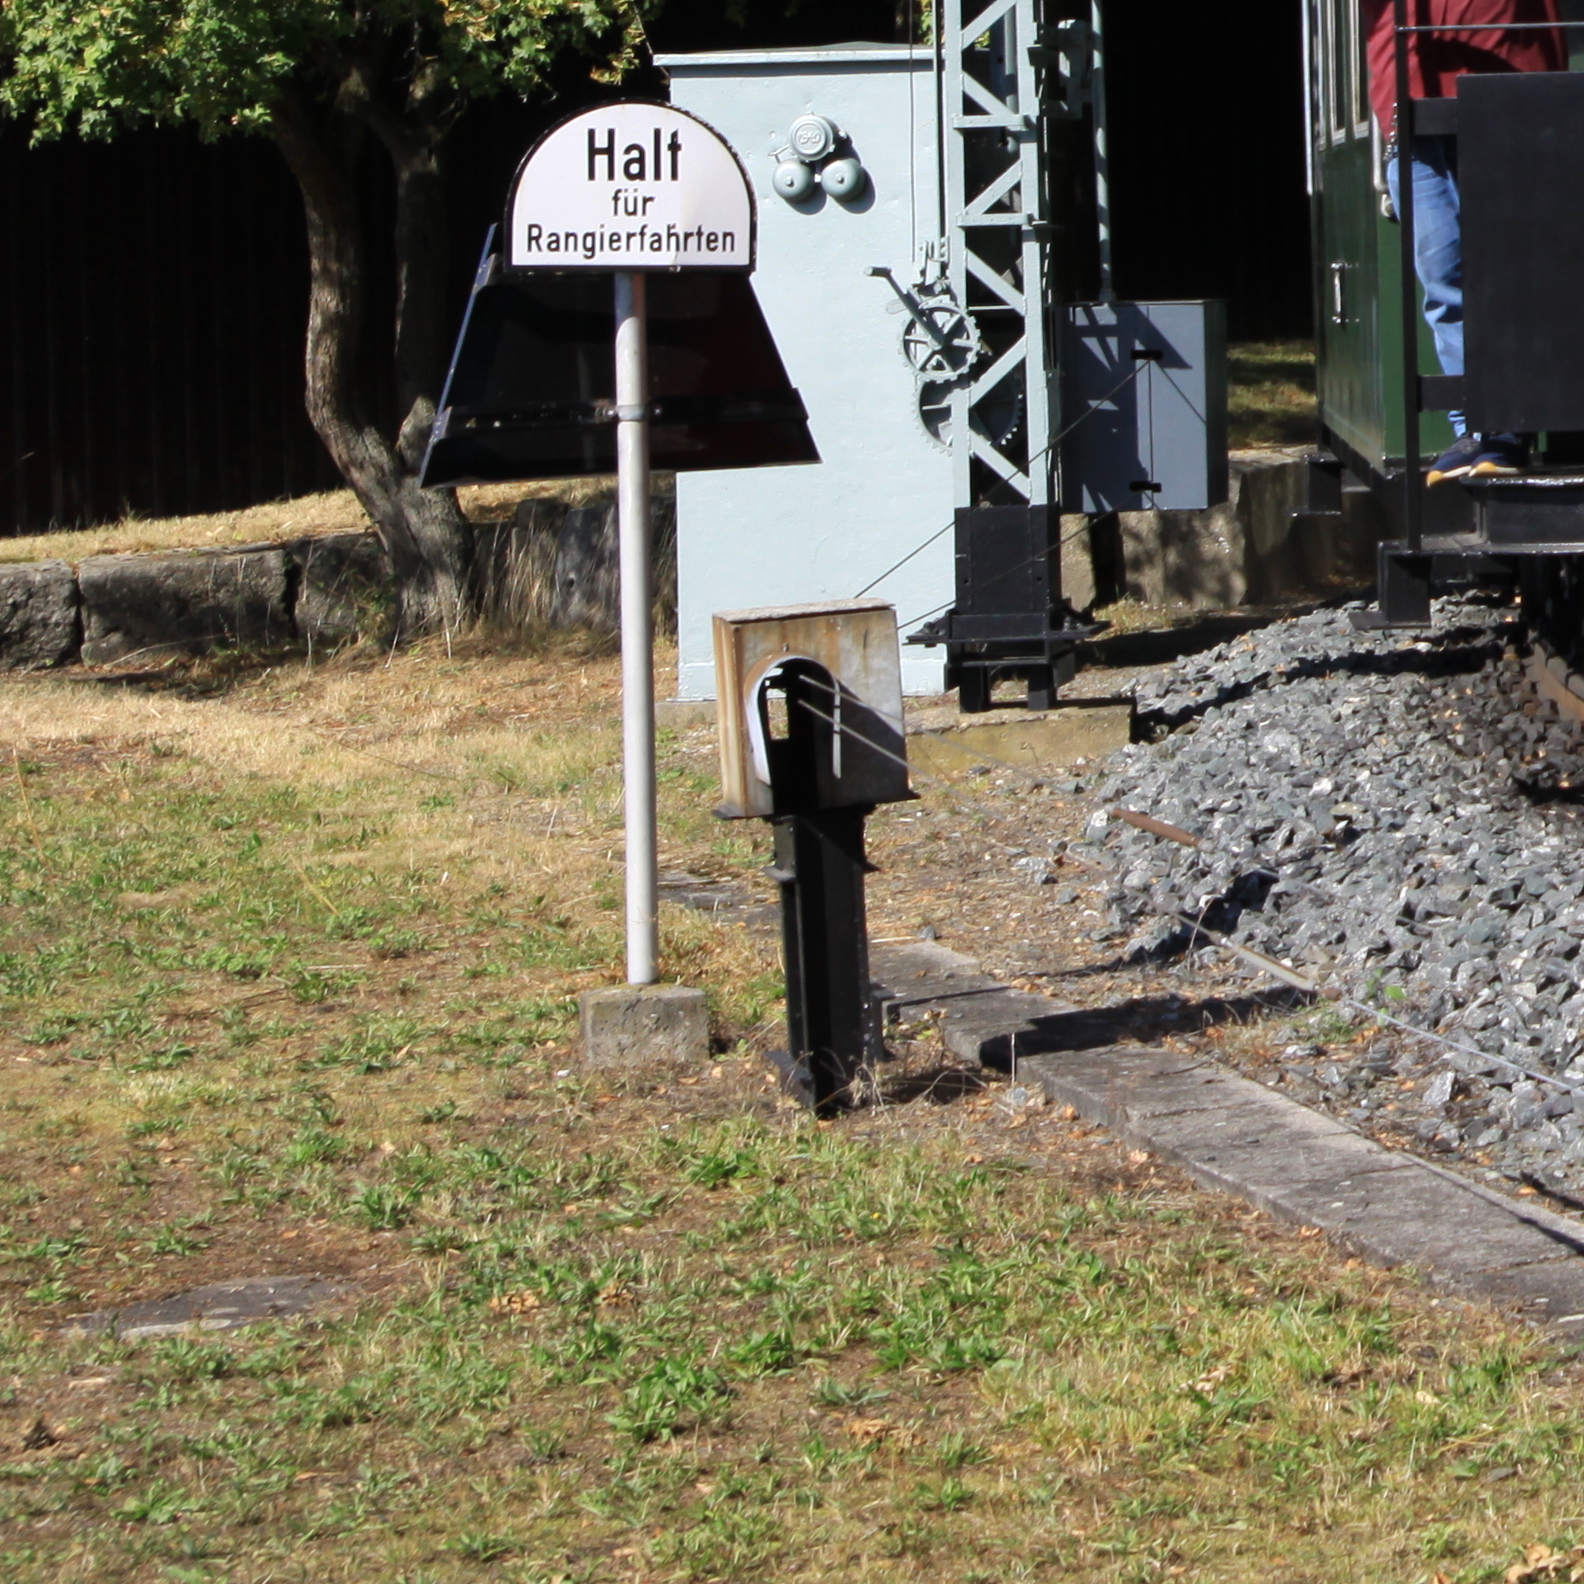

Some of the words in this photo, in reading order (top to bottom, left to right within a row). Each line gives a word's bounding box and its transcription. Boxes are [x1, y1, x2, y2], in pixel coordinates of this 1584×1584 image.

[587, 127, 682, 182] Halt
[612, 189, 655, 217] für
[526, 223, 736, 259] Rangierfahrten
